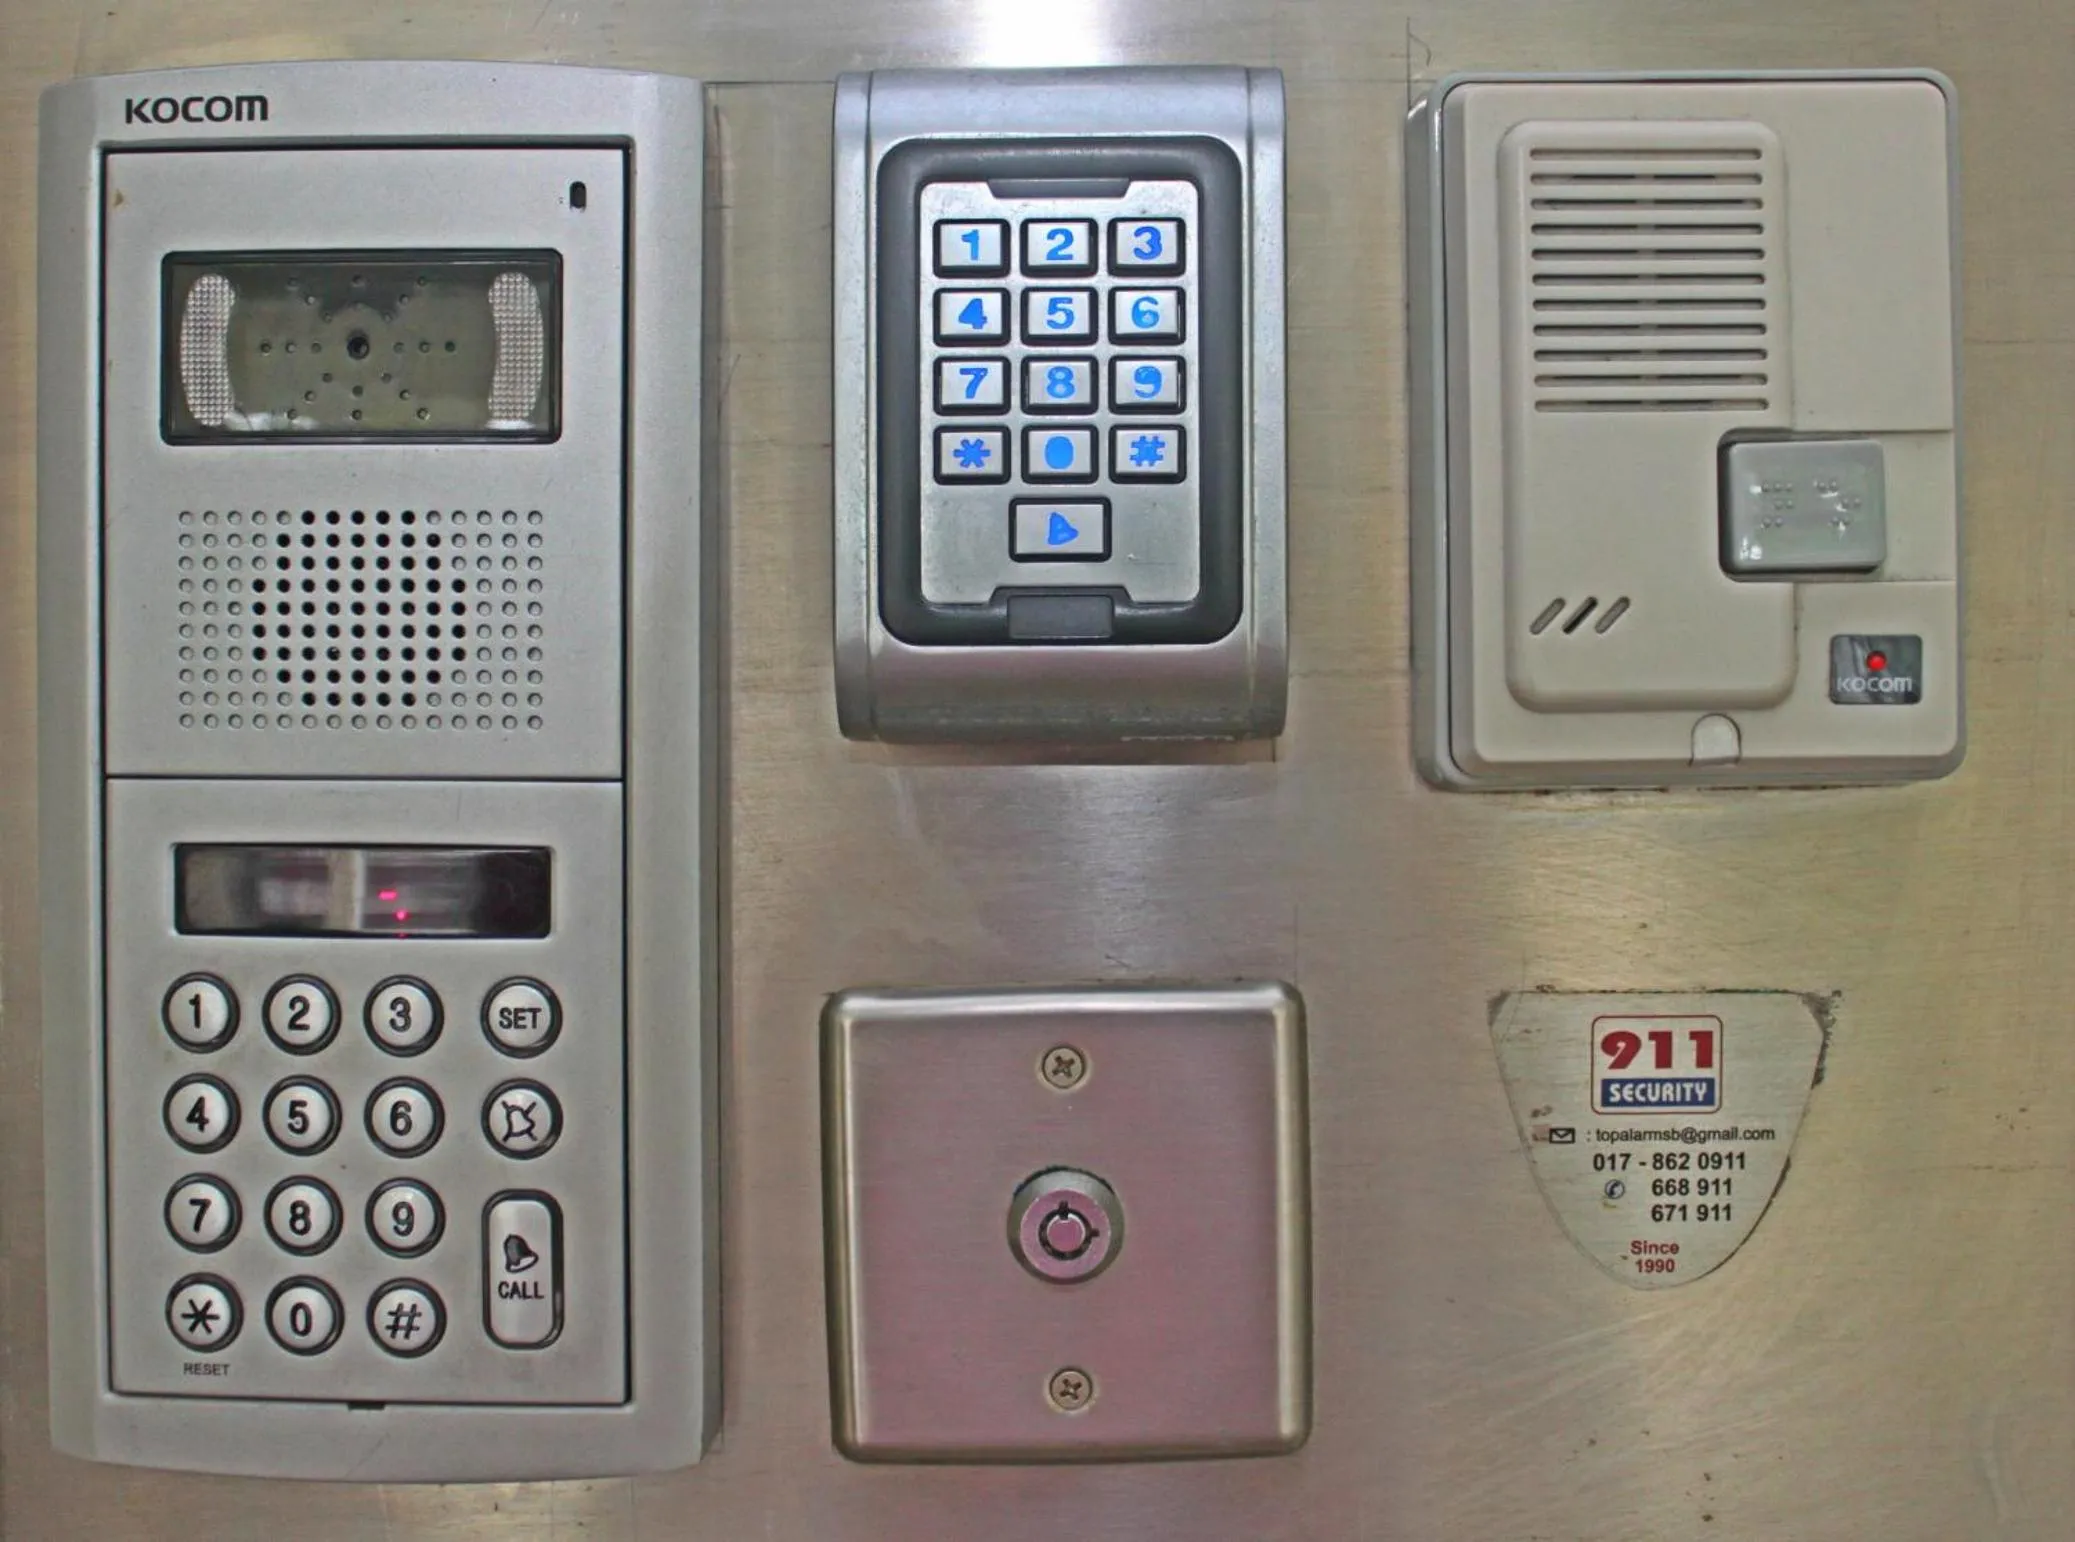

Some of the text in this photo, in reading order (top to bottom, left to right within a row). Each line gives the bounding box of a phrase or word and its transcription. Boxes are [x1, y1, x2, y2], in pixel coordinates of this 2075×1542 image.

[125, 95, 268, 124] KOCOM
[960, 226, 1164, 262] 1 2 3
[957, 296, 1161, 330] 4 5 6
[958, 365, 1164, 399] 7 8 9
[1836, 676, 1912, 693] KOCOM
[189, 994, 542, 1033] 1 2 3 SET
[1601, 1030, 1713, 1070] 911
[1609, 1083, 1706, 1102] SECURITY
[186, 1096, 412, 1136] 4 5 6
[1596, 1127, 1775, 1145] topalarmsb@gmail.com
[1593, 1153, 1631, 1172] 017
[1652, 1152, 1690, 1171] 862
[1698, 1152, 1746, 1171] 0911
[1651, 1178, 1732, 1197] 668 911
[189, 1198, 414, 1236] 7 8 9
[1651, 1203, 1731, 1222] 671 911
[1631, 1240, 1679, 1255] Since
[1636, 1259, 1675, 1273] 1990
[497, 1281, 545, 1301] CALL
[290, 1302, 312, 1337] 0
[183, 1362, 231, 1376] RESET
